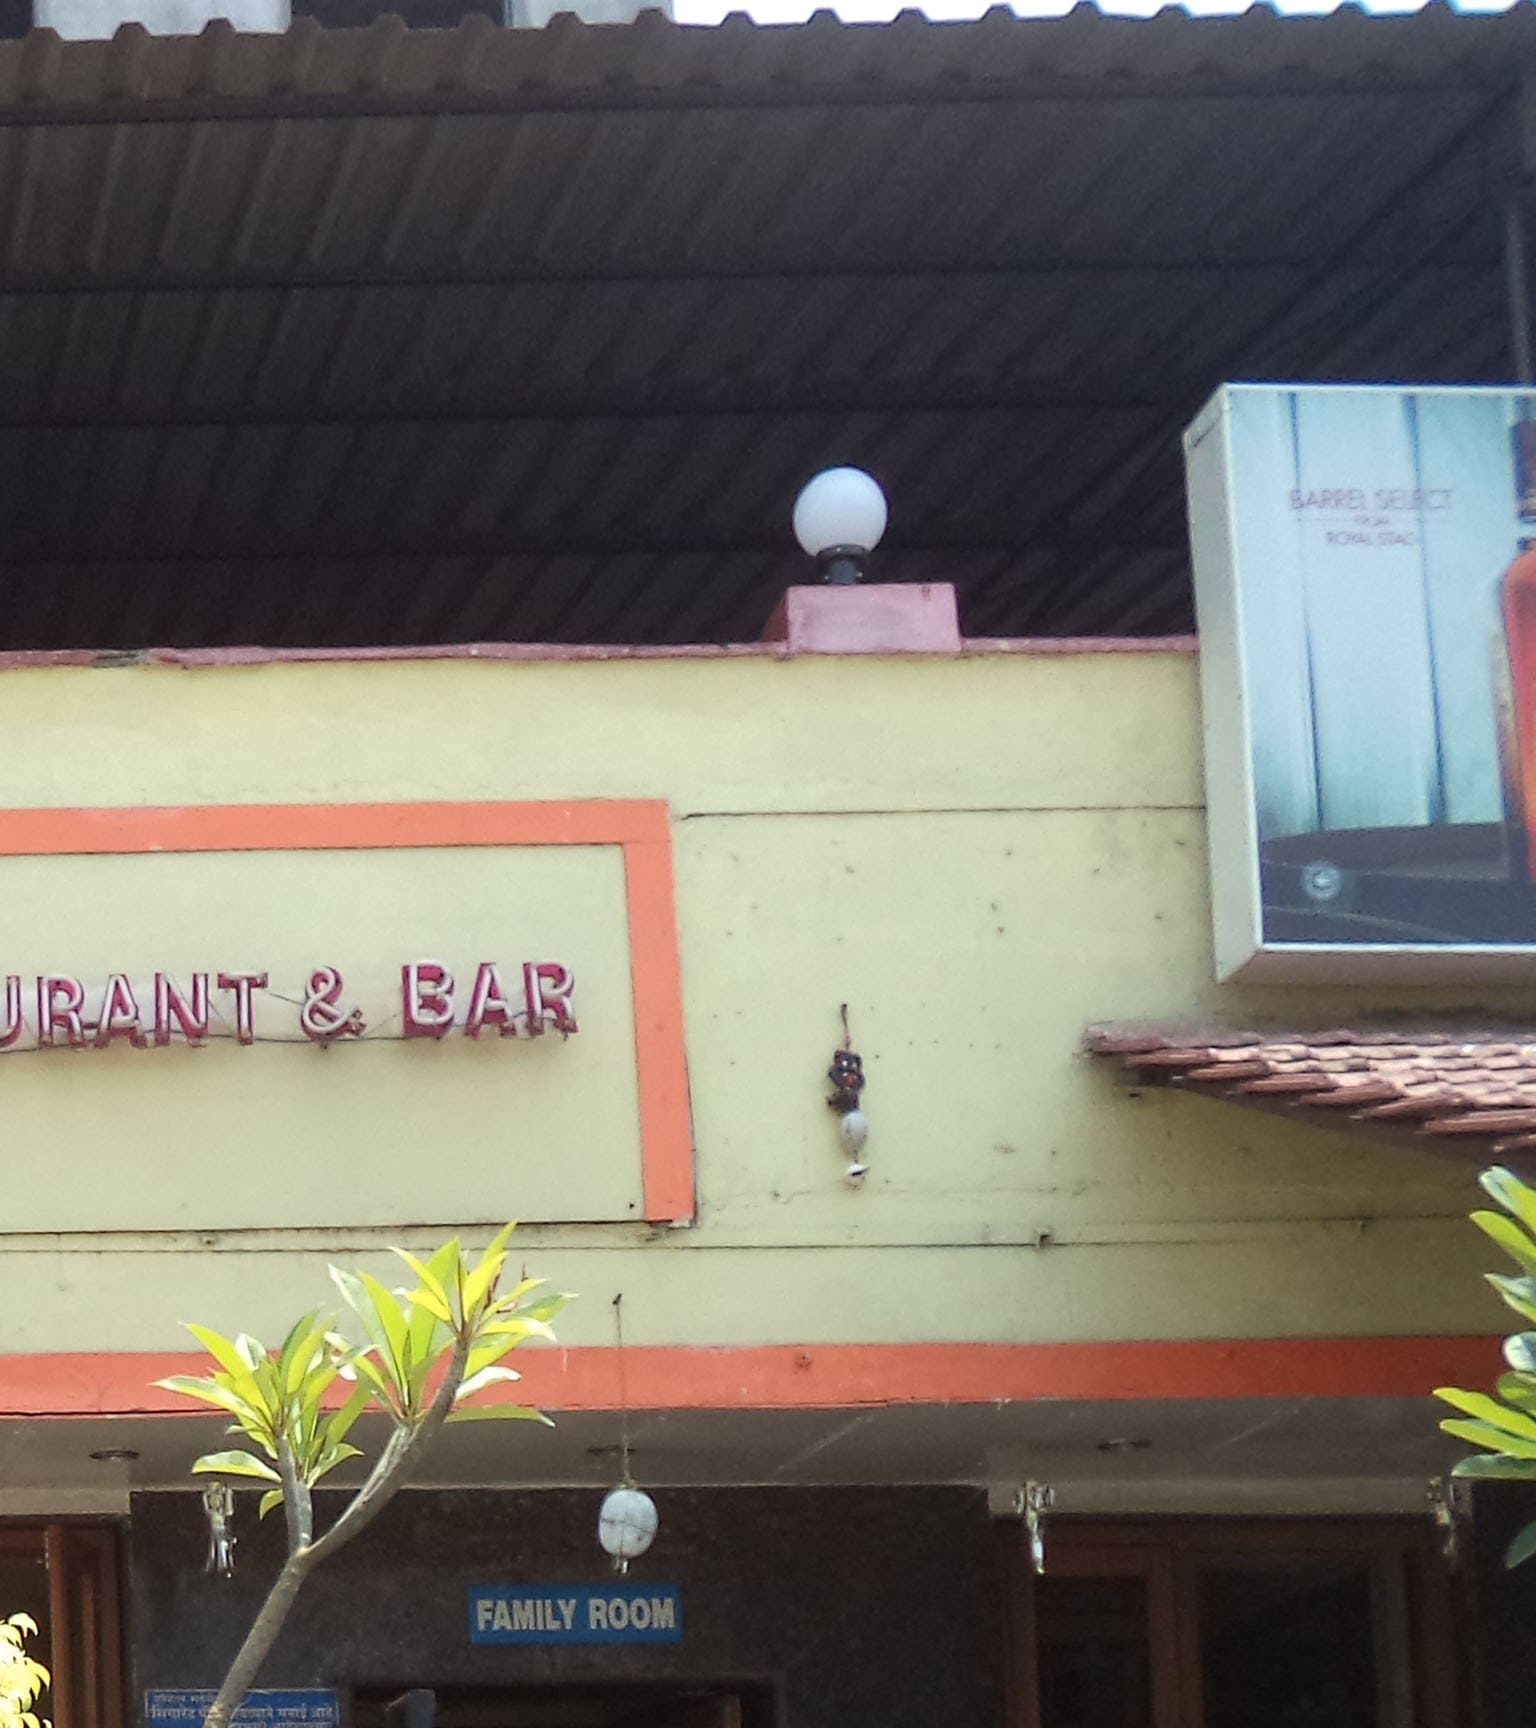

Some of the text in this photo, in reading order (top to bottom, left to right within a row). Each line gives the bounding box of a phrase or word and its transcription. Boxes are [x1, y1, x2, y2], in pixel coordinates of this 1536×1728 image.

[300, 966, 368, 1042] &
[400, 958, 579, 1042] BAR
[478, 1597, 676, 1631] FAMILY ROOM
